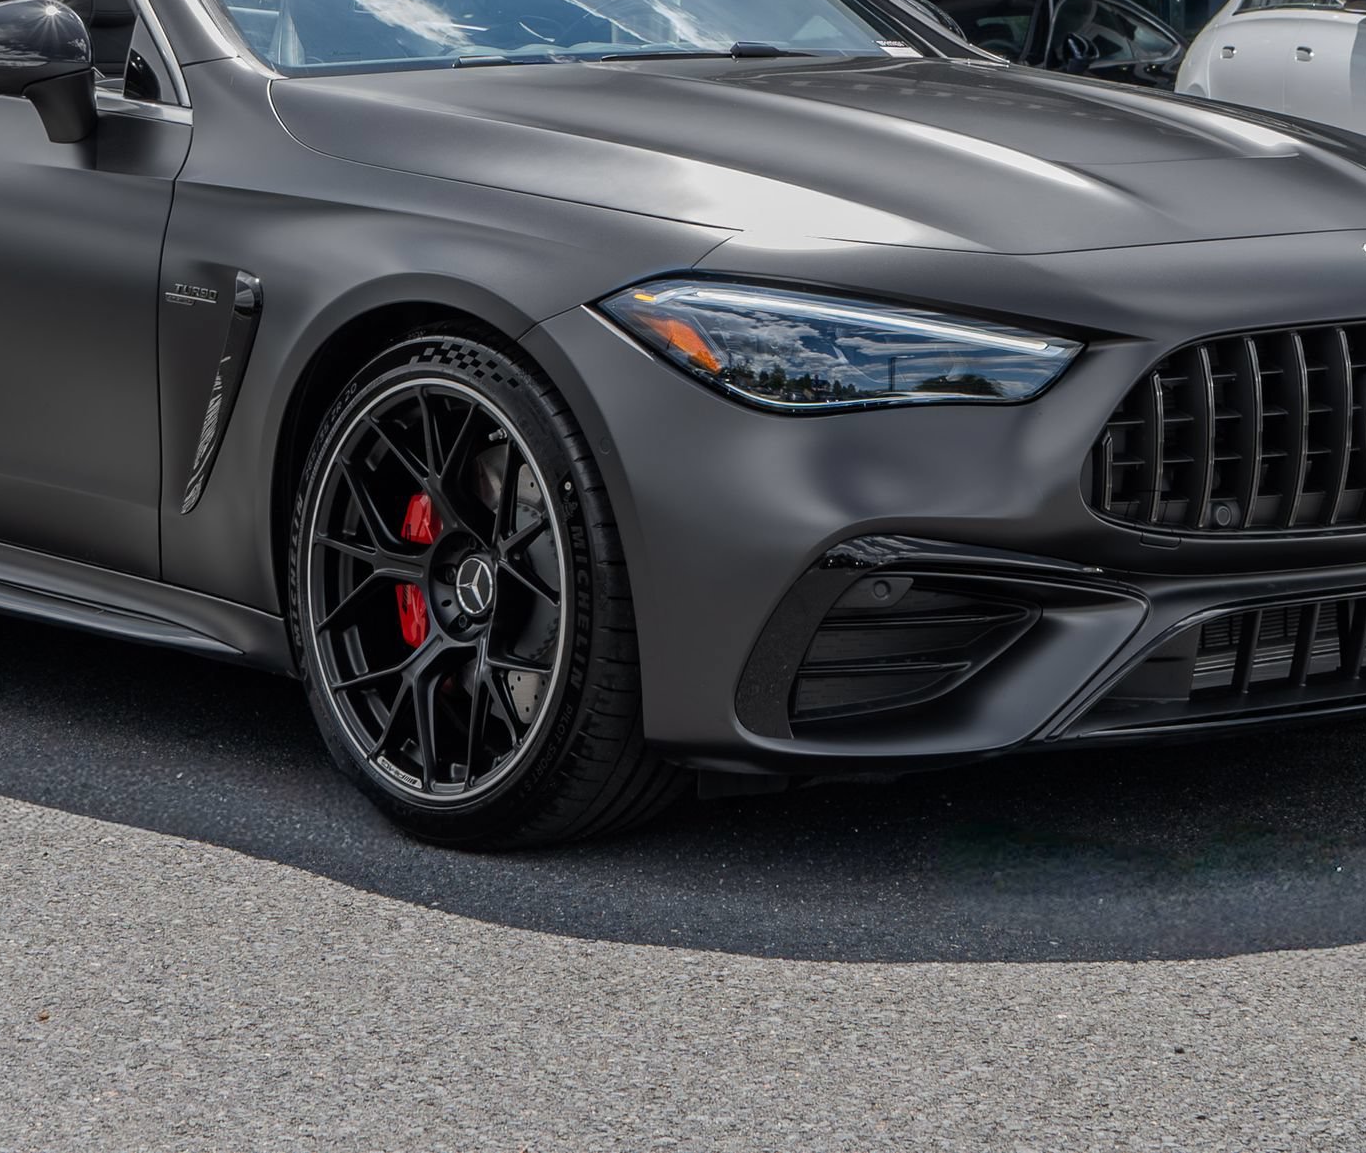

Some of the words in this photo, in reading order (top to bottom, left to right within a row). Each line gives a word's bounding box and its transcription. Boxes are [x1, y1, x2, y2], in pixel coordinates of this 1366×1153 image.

[175, 283, 218, 300] TURBO
[570, 525, 591, 689] MICHELIN
[555, 704, 573, 744] PILOT
[531, 743, 556, 784] SPORT
